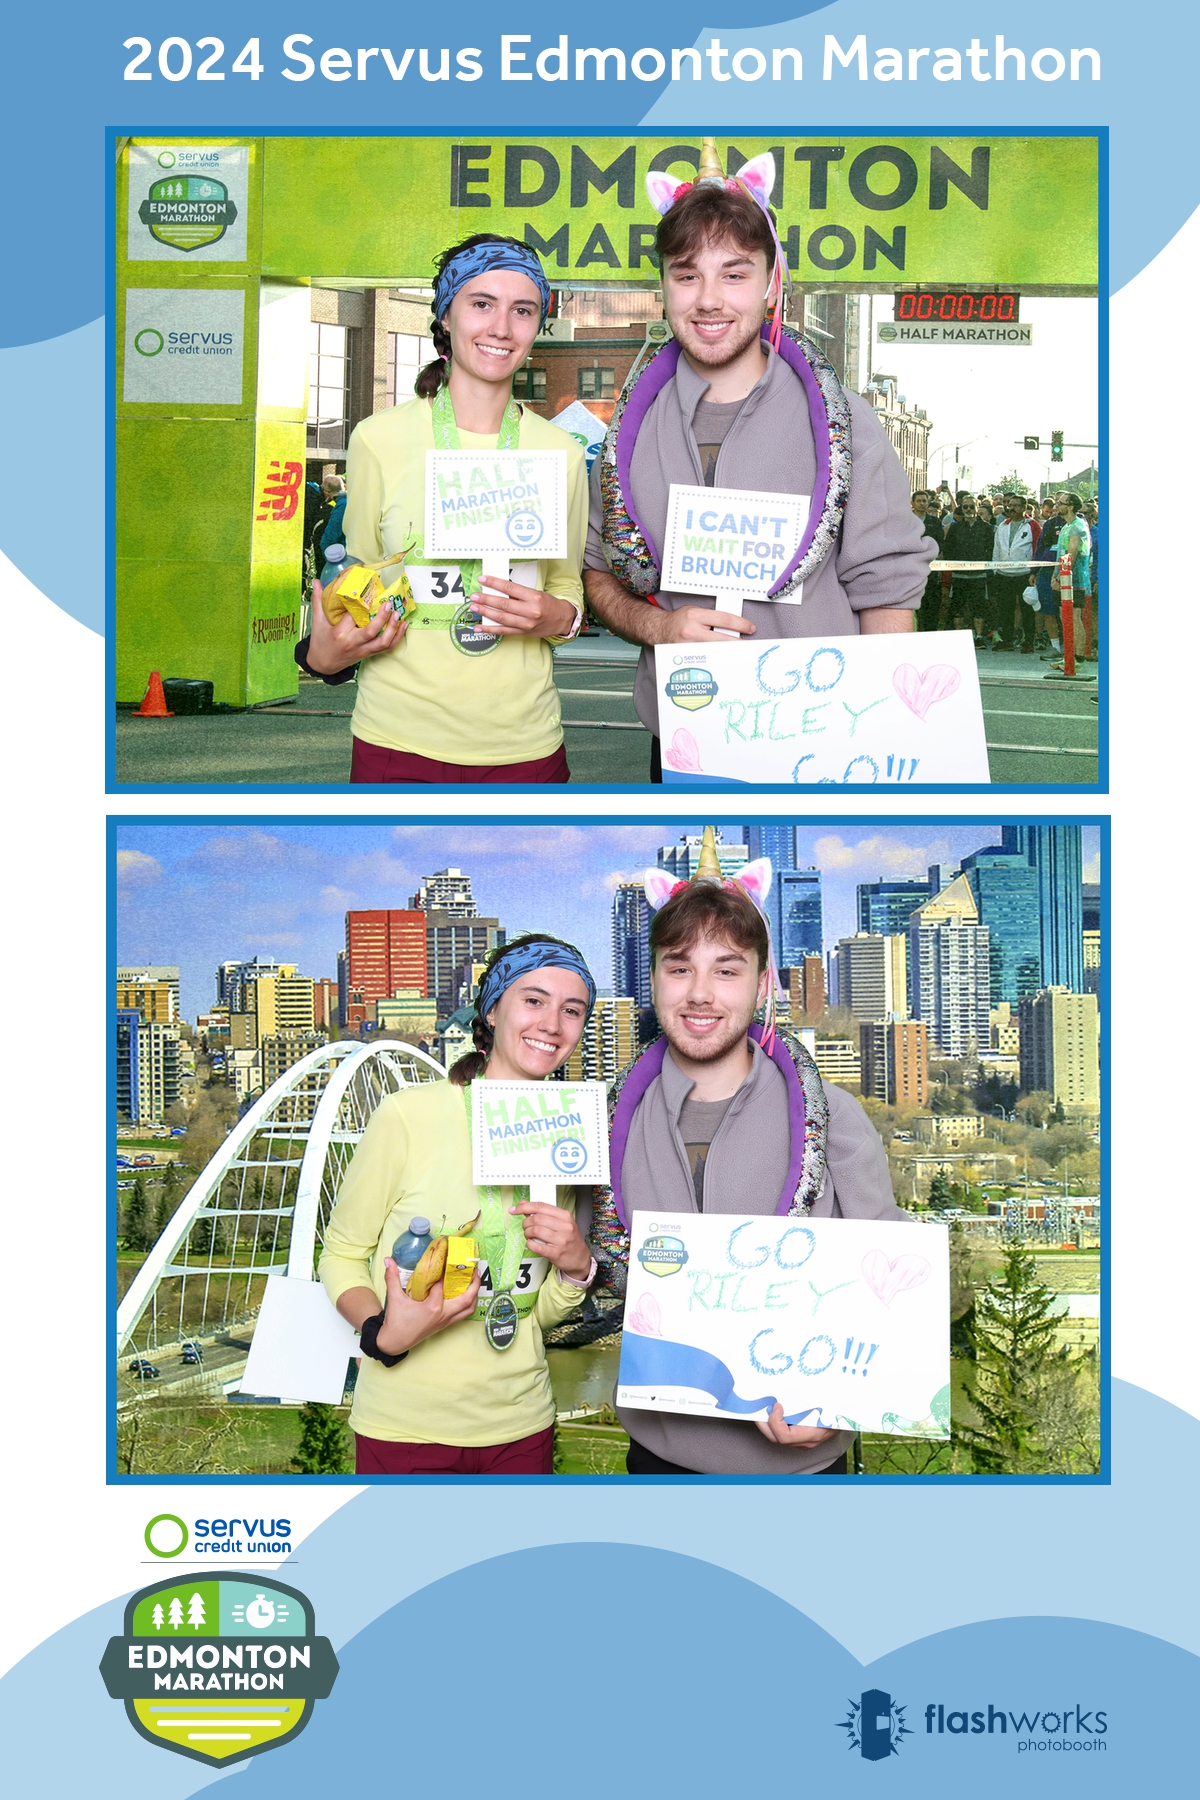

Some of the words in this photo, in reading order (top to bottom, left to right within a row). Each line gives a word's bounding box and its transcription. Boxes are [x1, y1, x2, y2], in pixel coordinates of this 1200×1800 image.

[178, 152, 219, 161] servus
[149, 203, 227, 214] EDMONTON
[160, 214, 215, 222] MARATHON
[523, 222, 906, 271] MARHON
[168, 332, 233, 345] servus
[900, 327, 939, 339] HALF
[942, 328, 1031, 341] MARATHON
[168, 345, 200, 355] credit
[202, 347, 233, 355] union
[436, 457, 534, 499] HALF
[441, 482, 539, 513] MARATHON
[443, 497, 543, 530] FINISHER!
[685, 509, 694, 530] I
[698, 510, 788, 538] CAN'T
[683, 534, 739, 555] WAIT
[742, 540, 785, 560] FOR
[681, 555, 777, 582] BRUNCH
[754, 645, 846, 696] GO
[670, 683, 713, 691] EDMONTON
[719, 695, 893, 744] RILEY
[483, 1088, 577, 1127] HALF
[488, 1112, 582, 1140] MARATHON
[490, 1126, 587, 1157] FINISHER!
[643, 1250, 683, 1258] EDMONTON
[725, 1220, 817, 1270] GO
[686, 1268, 859, 1316] RILEY
[748, 1327, 880, 1377] GO!!!
